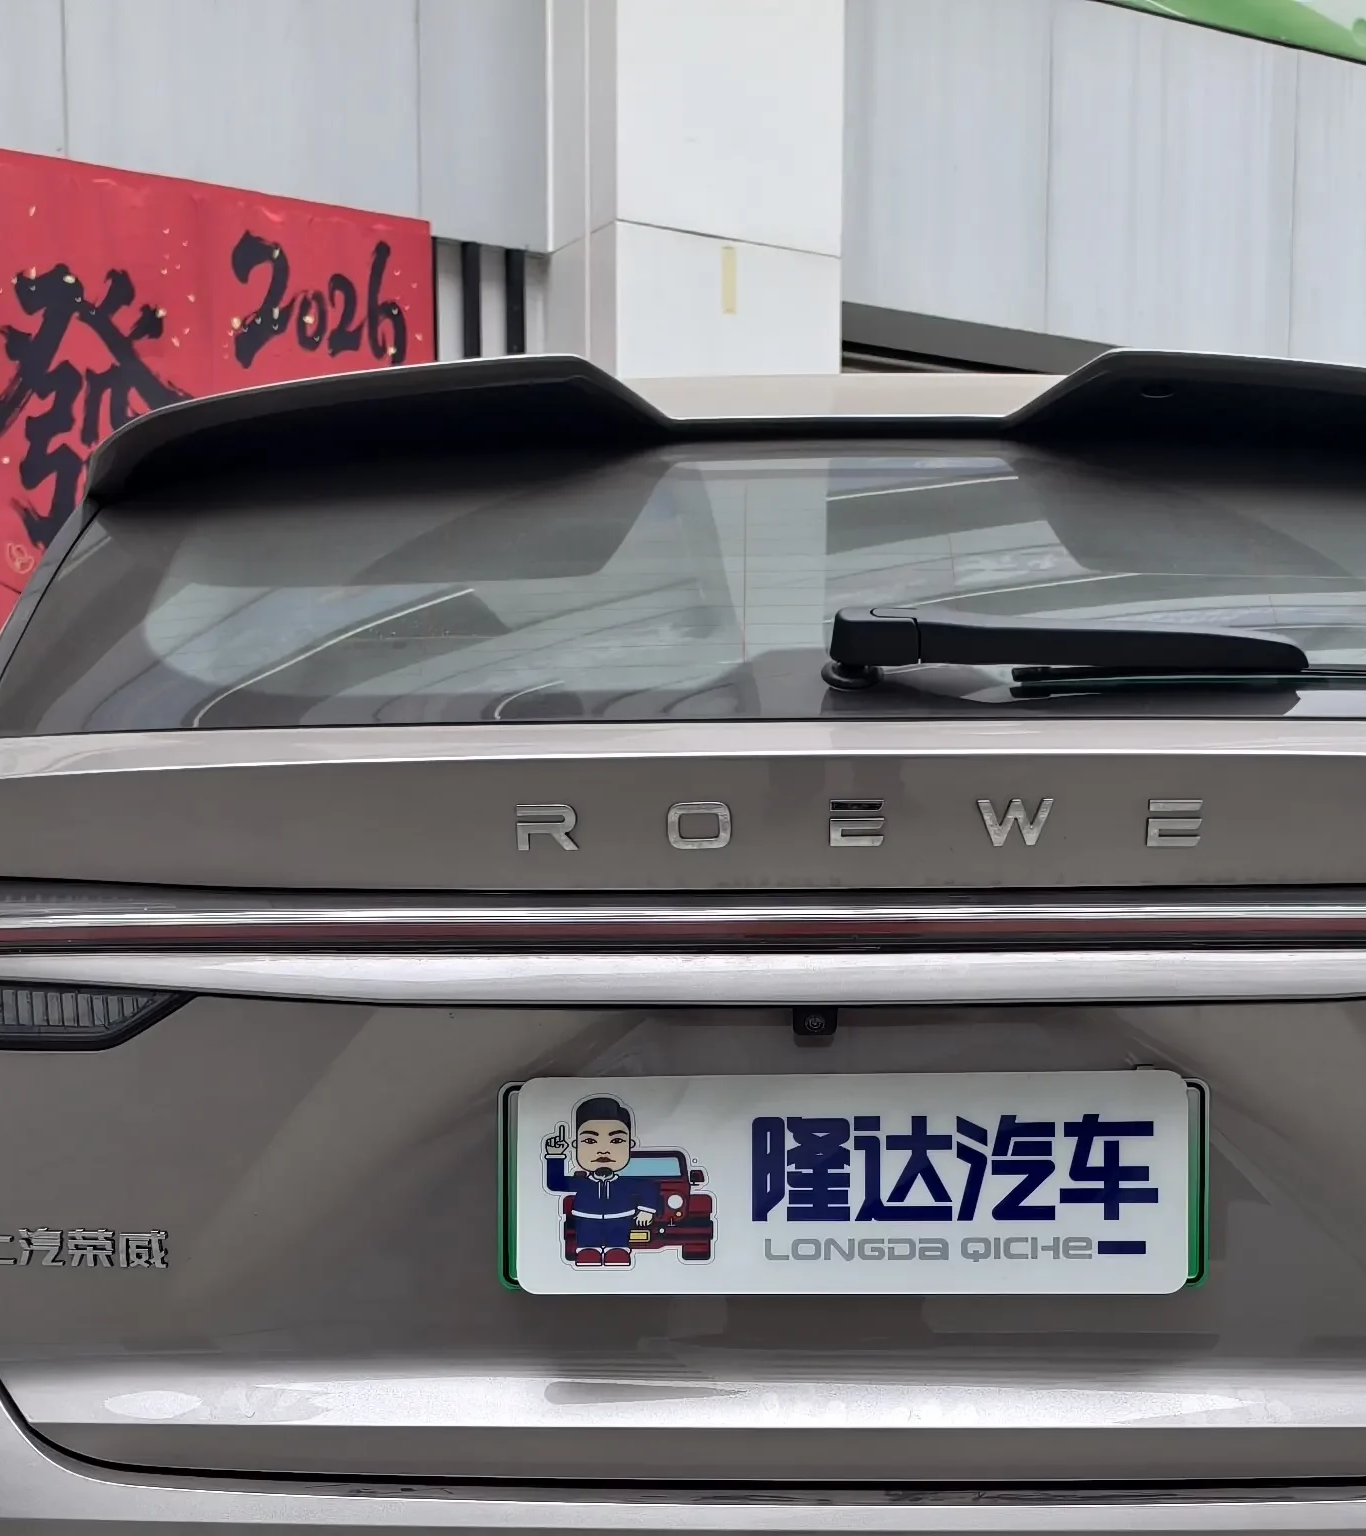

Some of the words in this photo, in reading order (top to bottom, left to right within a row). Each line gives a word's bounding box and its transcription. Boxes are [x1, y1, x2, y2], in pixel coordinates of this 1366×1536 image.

[232, 230, 406, 366] 2026
[515, 797, 1204, 852] ROEWE
[751, 1113, 1160, 1222] 隆达汽车
